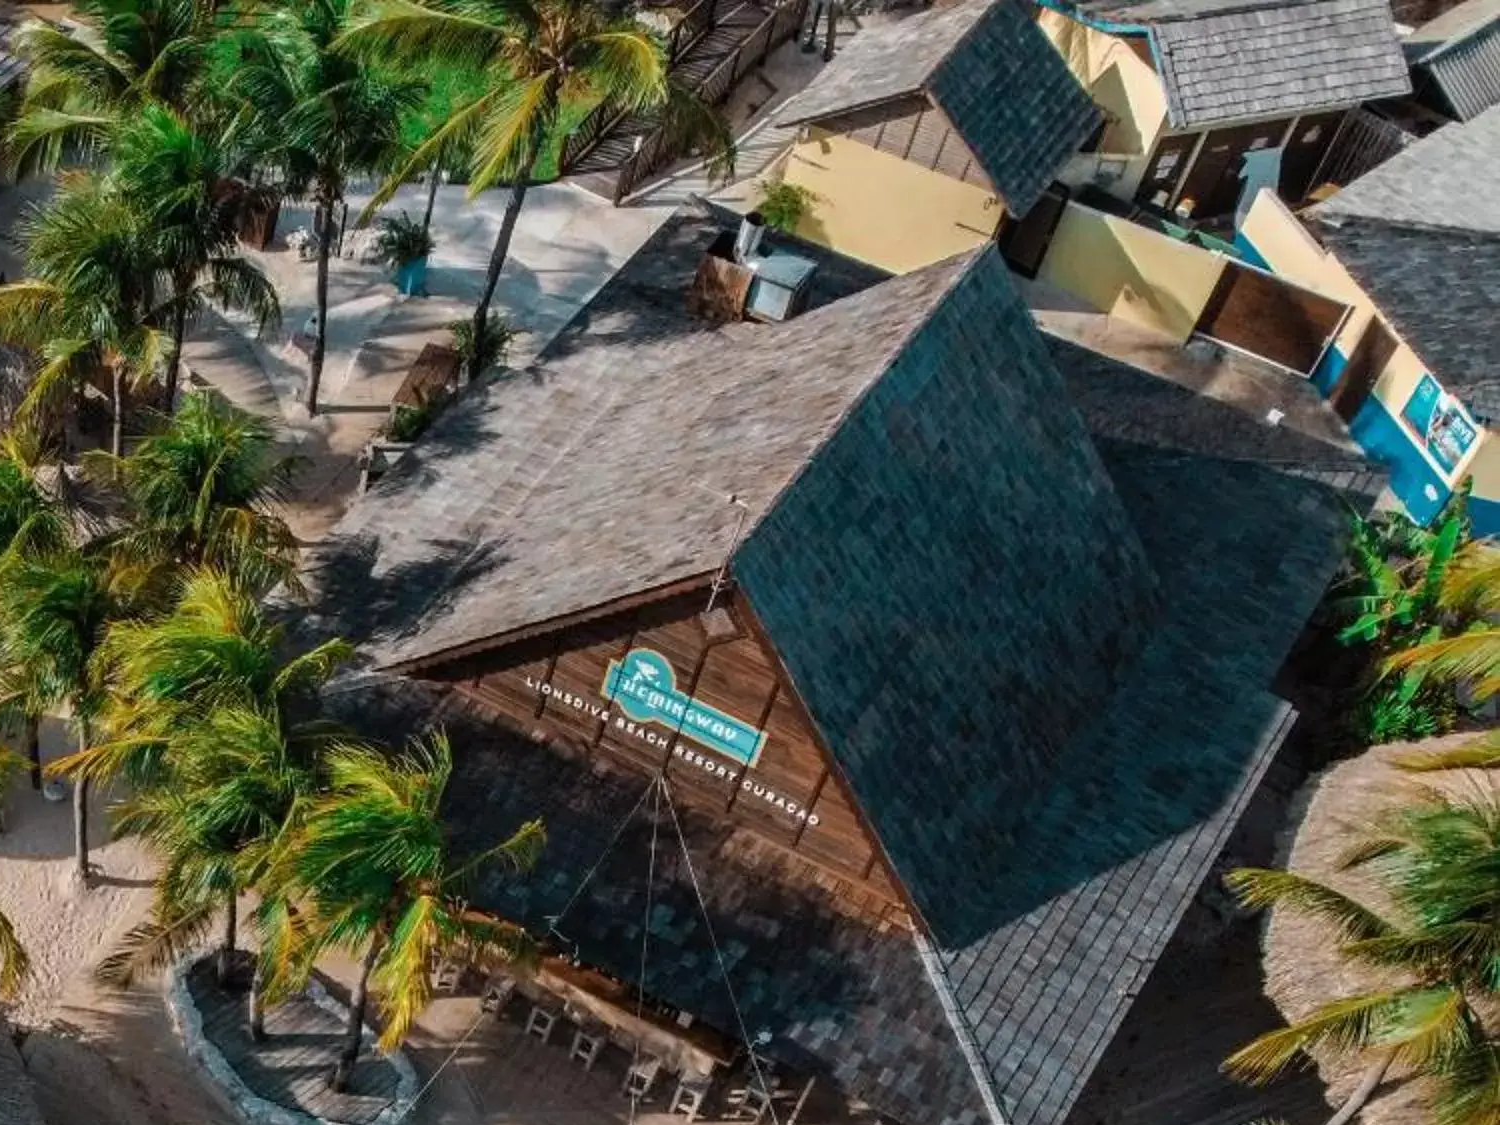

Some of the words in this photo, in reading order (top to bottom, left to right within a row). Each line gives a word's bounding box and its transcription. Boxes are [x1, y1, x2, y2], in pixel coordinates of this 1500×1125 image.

[524, 676, 610, 722] LIONSDIVE
[615, 717, 669, 750] BEACH
[674, 743, 737, 782] RESORT
